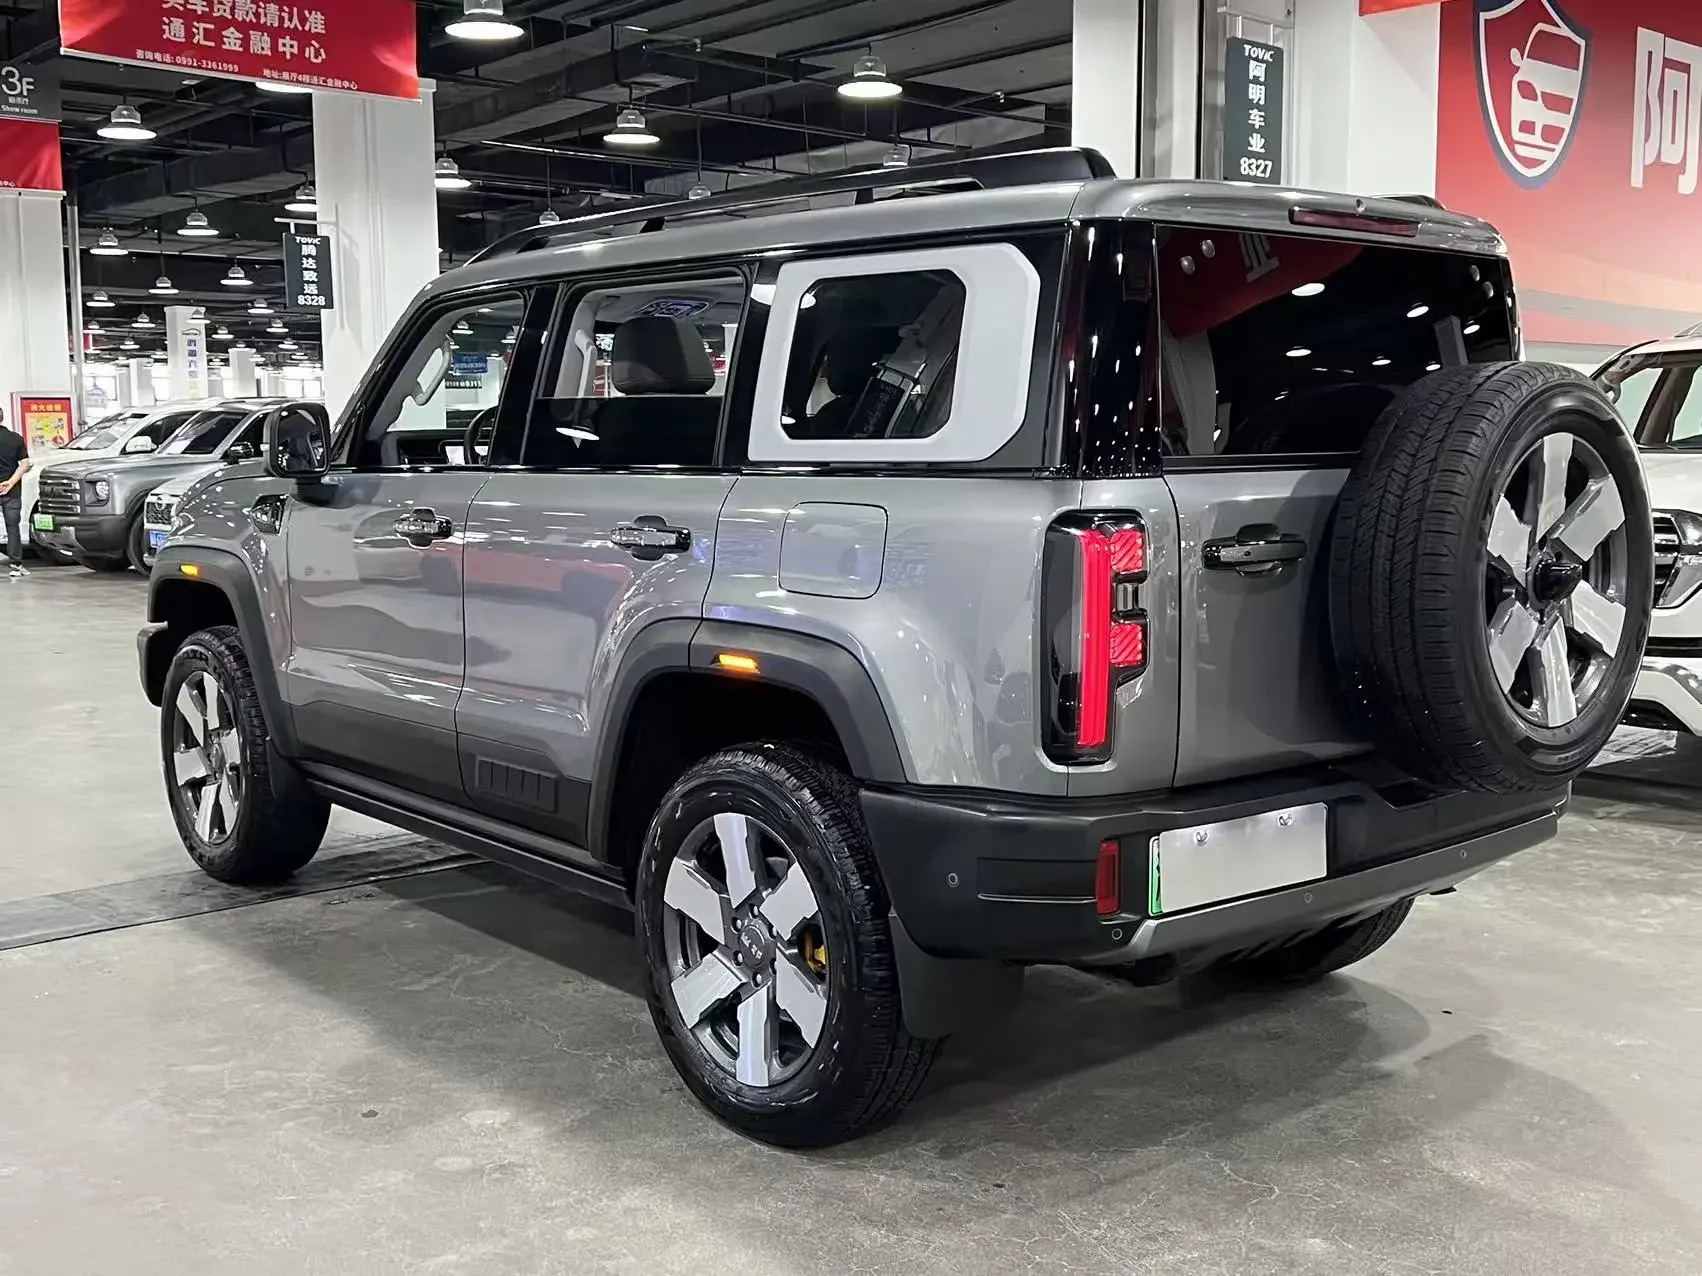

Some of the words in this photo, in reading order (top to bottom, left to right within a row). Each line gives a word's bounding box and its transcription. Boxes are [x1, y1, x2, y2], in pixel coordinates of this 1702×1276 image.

[161, 16, 326, 64] 通汇金融中心
[1, 66, 35, 96] 3F
[1247, 59, 1267, 153] 阿明车业
[1239, 156, 1273, 178] 8327
[297, 295, 326, 306] 8328
